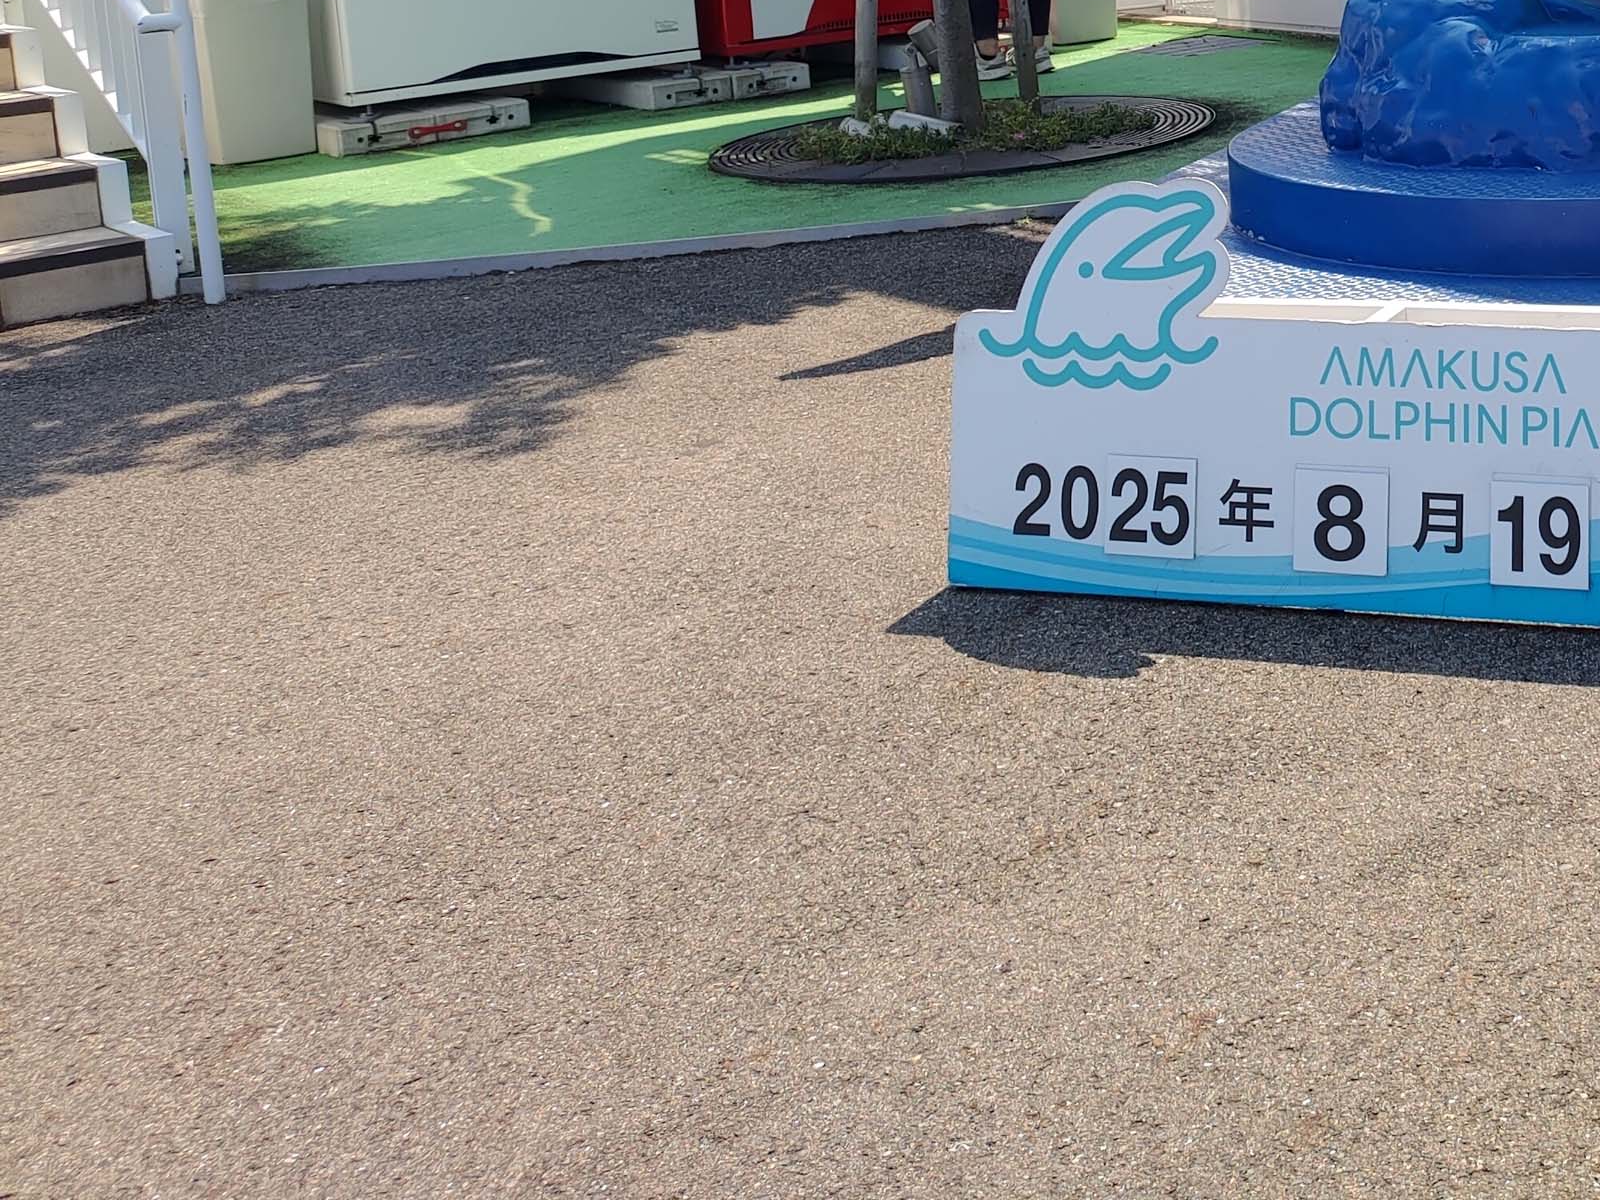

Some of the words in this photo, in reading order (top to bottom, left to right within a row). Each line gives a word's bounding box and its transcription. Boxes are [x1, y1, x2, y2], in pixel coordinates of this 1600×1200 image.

[1319, 345, 1567, 394] AMAKUSA
[1289, 396, 1508, 445] DOLPHIN
[1522, 405, 1600, 450] PIA
[1013, 462, 1190, 546] 2025
[1218, 478, 1275, 542] 年
[1313, 484, 1366, 562] 8
[1412, 491, 1465, 554] 月
[1497, 495, 1581, 576] 19
